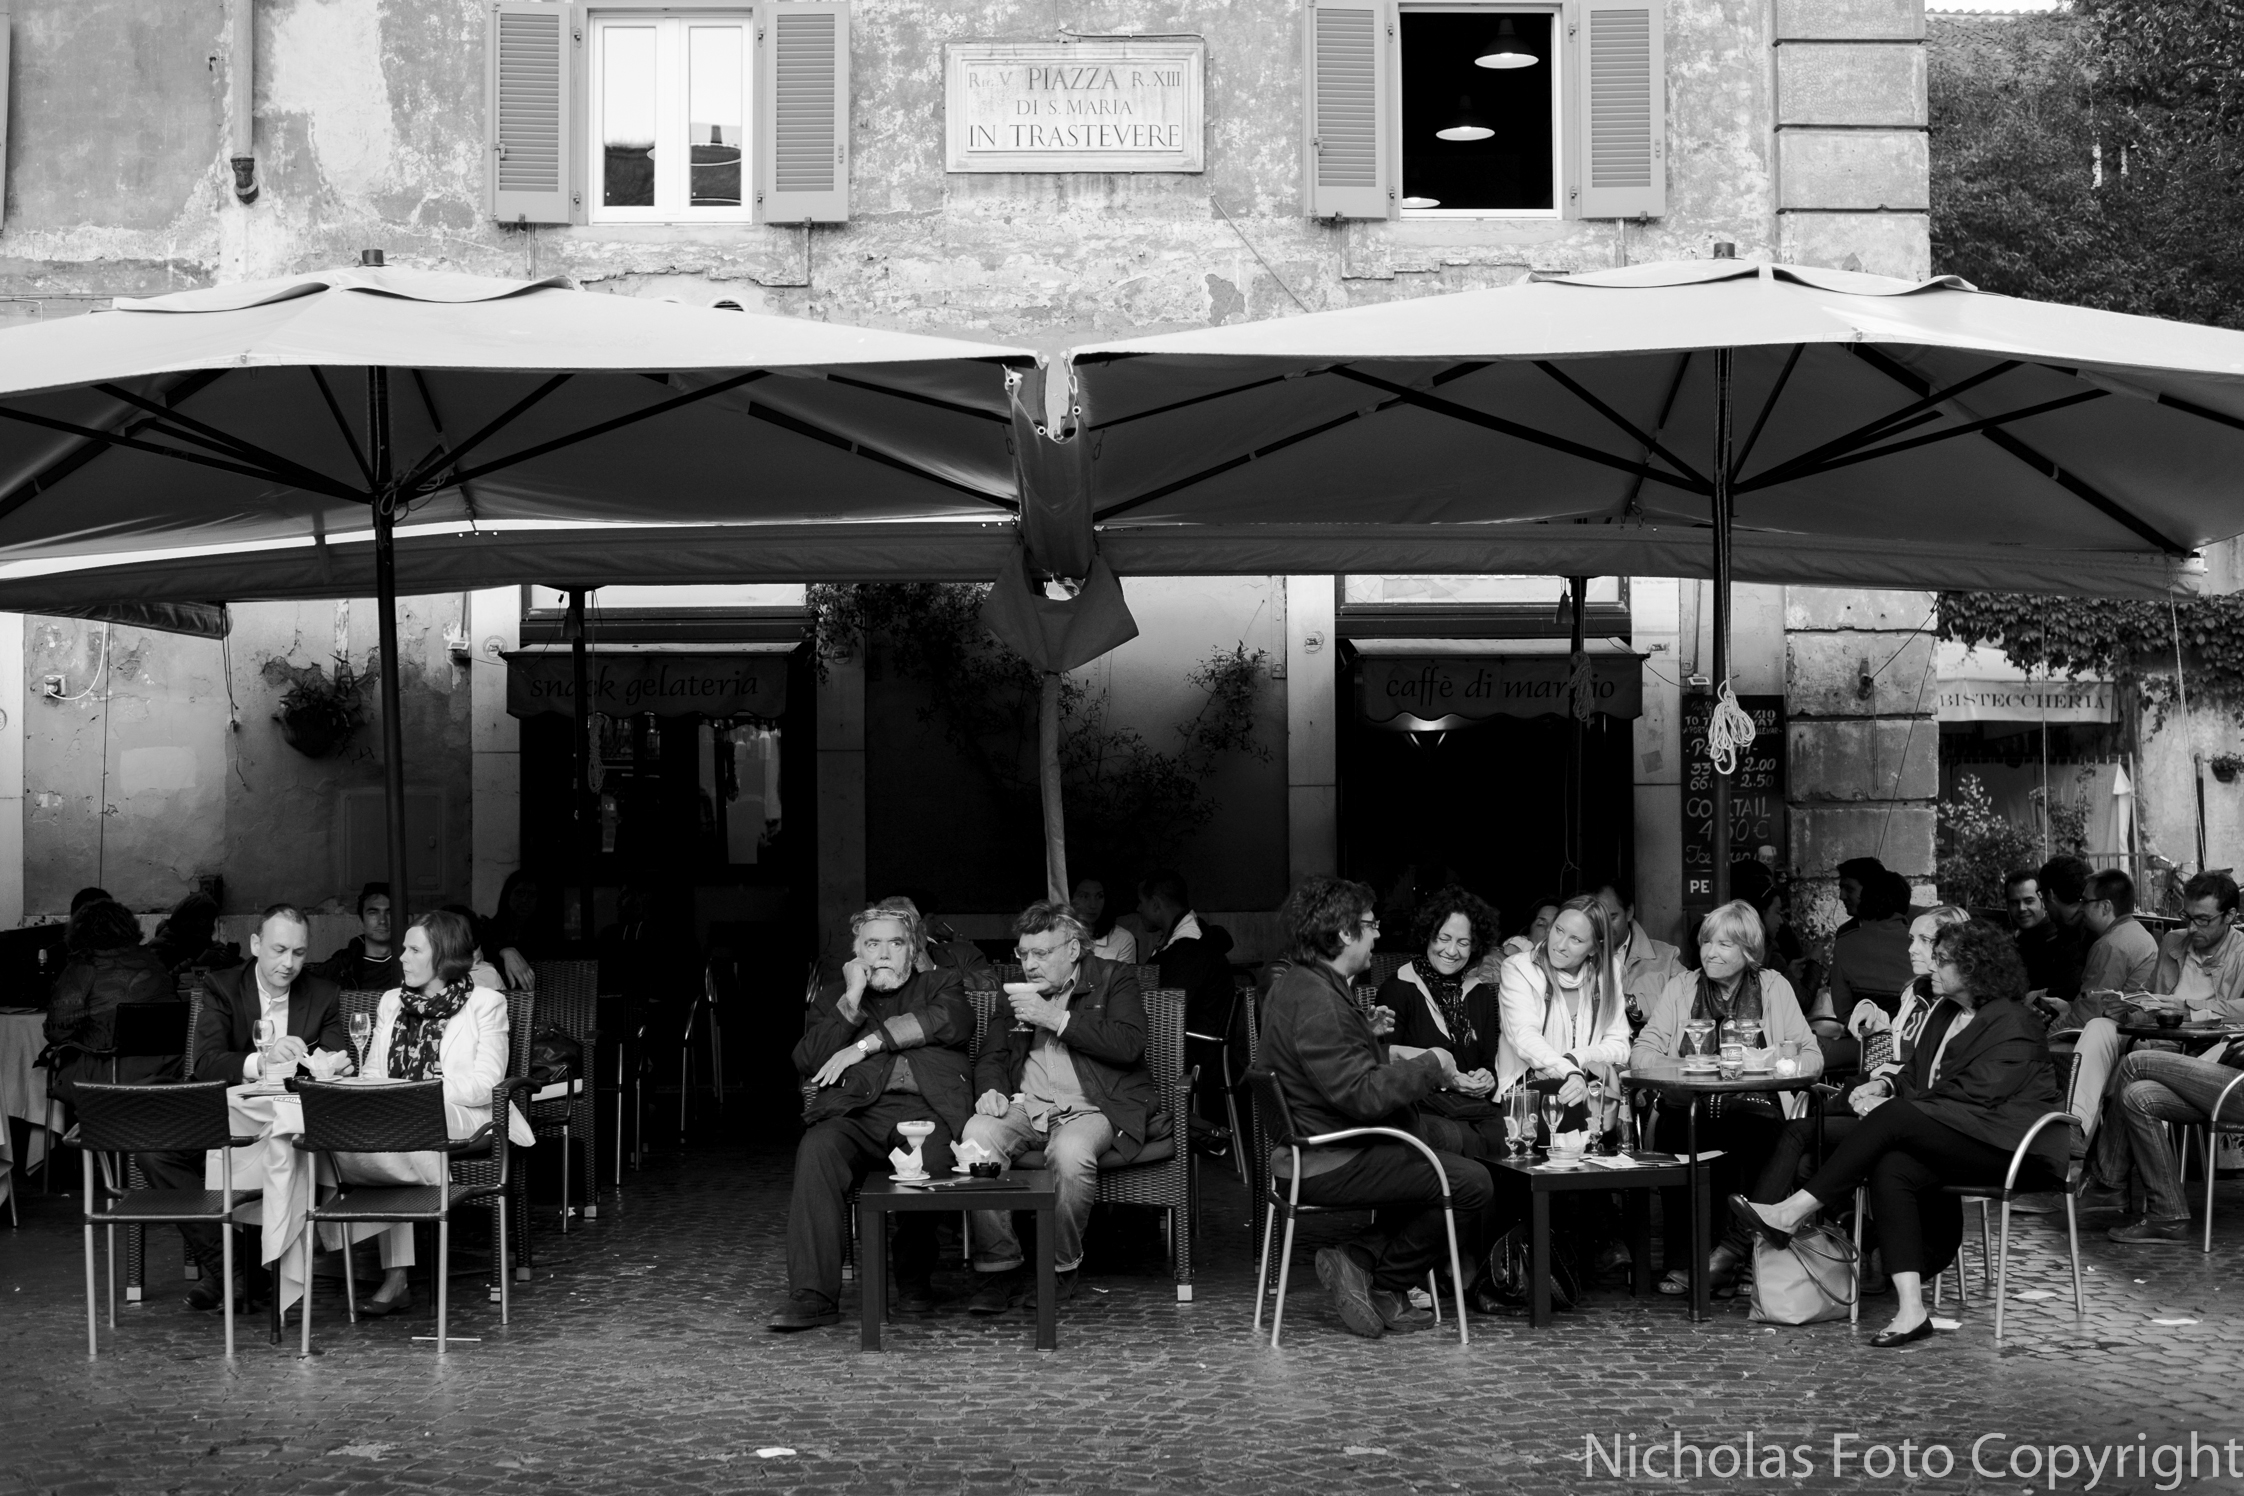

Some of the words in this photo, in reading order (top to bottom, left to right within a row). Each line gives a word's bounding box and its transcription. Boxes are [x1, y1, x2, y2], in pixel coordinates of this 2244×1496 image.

[1028, 67, 1119, 90] PIAZZA
[1016, 100, 1038, 115] DI
[969, 124, 996, 147] IN
[1009, 124, 1181, 147] TRASTEVERE
[625, 665, 759, 706] gelateria
[1385, 666, 1454, 707] caffè
[1464, 668, 1493, 699] di
[1503, 673, 1615, 699] mario
[1939, 693, 2106, 709] BISTECCHERIA
[1684, 715, 1699, 726] TO
[1742, 756, 1777, 772] 2.00
[1740, 773, 1775, 788] 2.50
